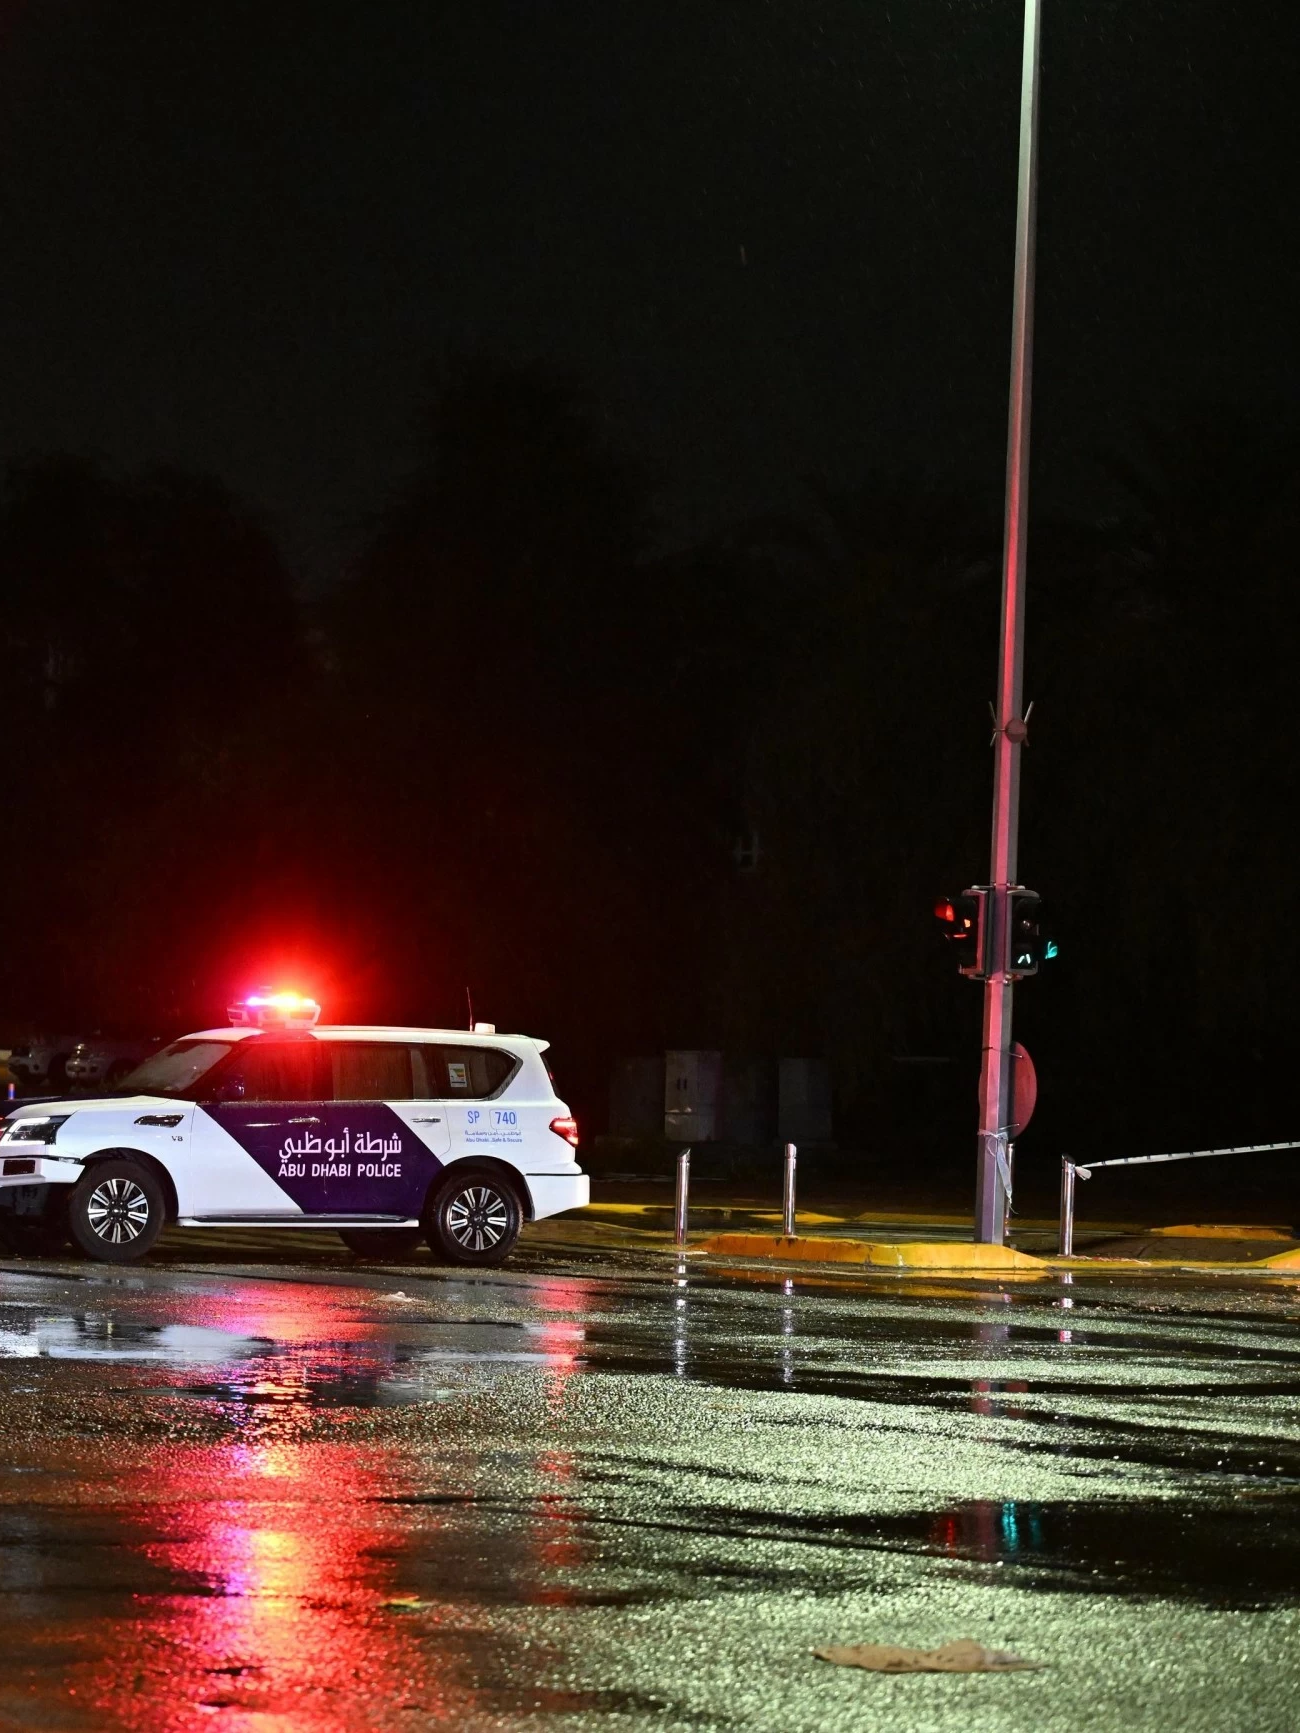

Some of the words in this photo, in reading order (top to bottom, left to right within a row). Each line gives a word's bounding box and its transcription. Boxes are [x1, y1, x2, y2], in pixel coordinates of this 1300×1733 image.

[467, 1110, 480, 1124] SP
[494, 1111, 516, 1125] 740
[354, 1132, 402, 1162] شرطة
[278, 1163, 306, 1177] ABU
[311, 1163, 351, 1177] DHABI
[357, 1163, 402, 1177] POLICE
